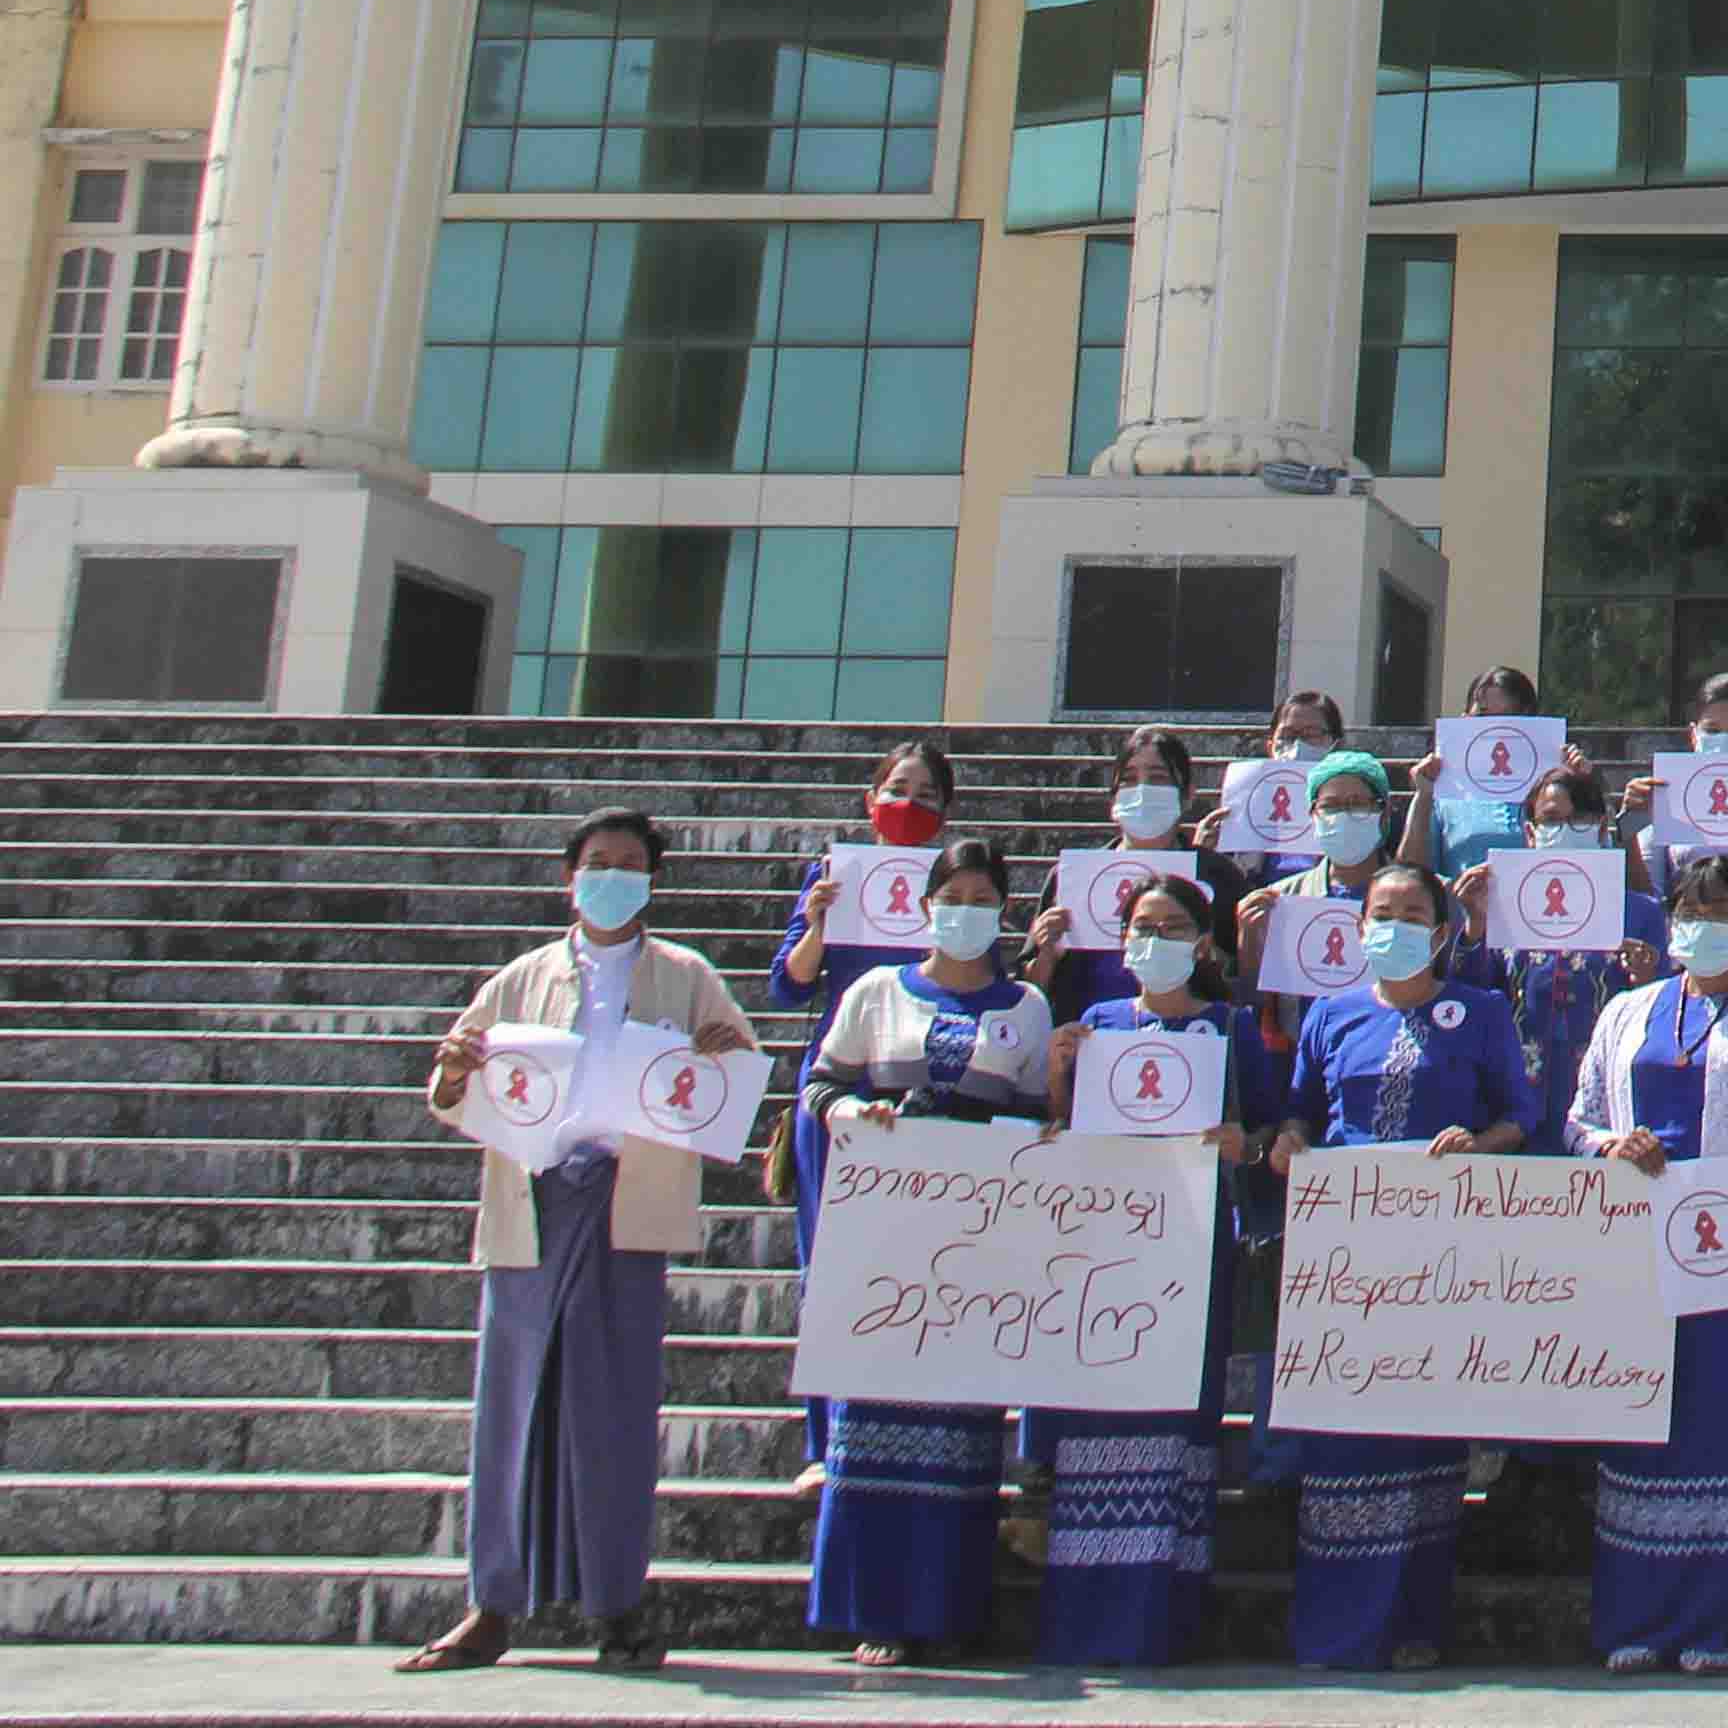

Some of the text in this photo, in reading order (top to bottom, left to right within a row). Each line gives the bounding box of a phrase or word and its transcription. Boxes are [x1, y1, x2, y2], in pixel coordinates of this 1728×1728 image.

[1275, 1327, 1665, 1409] #Reject the Military
